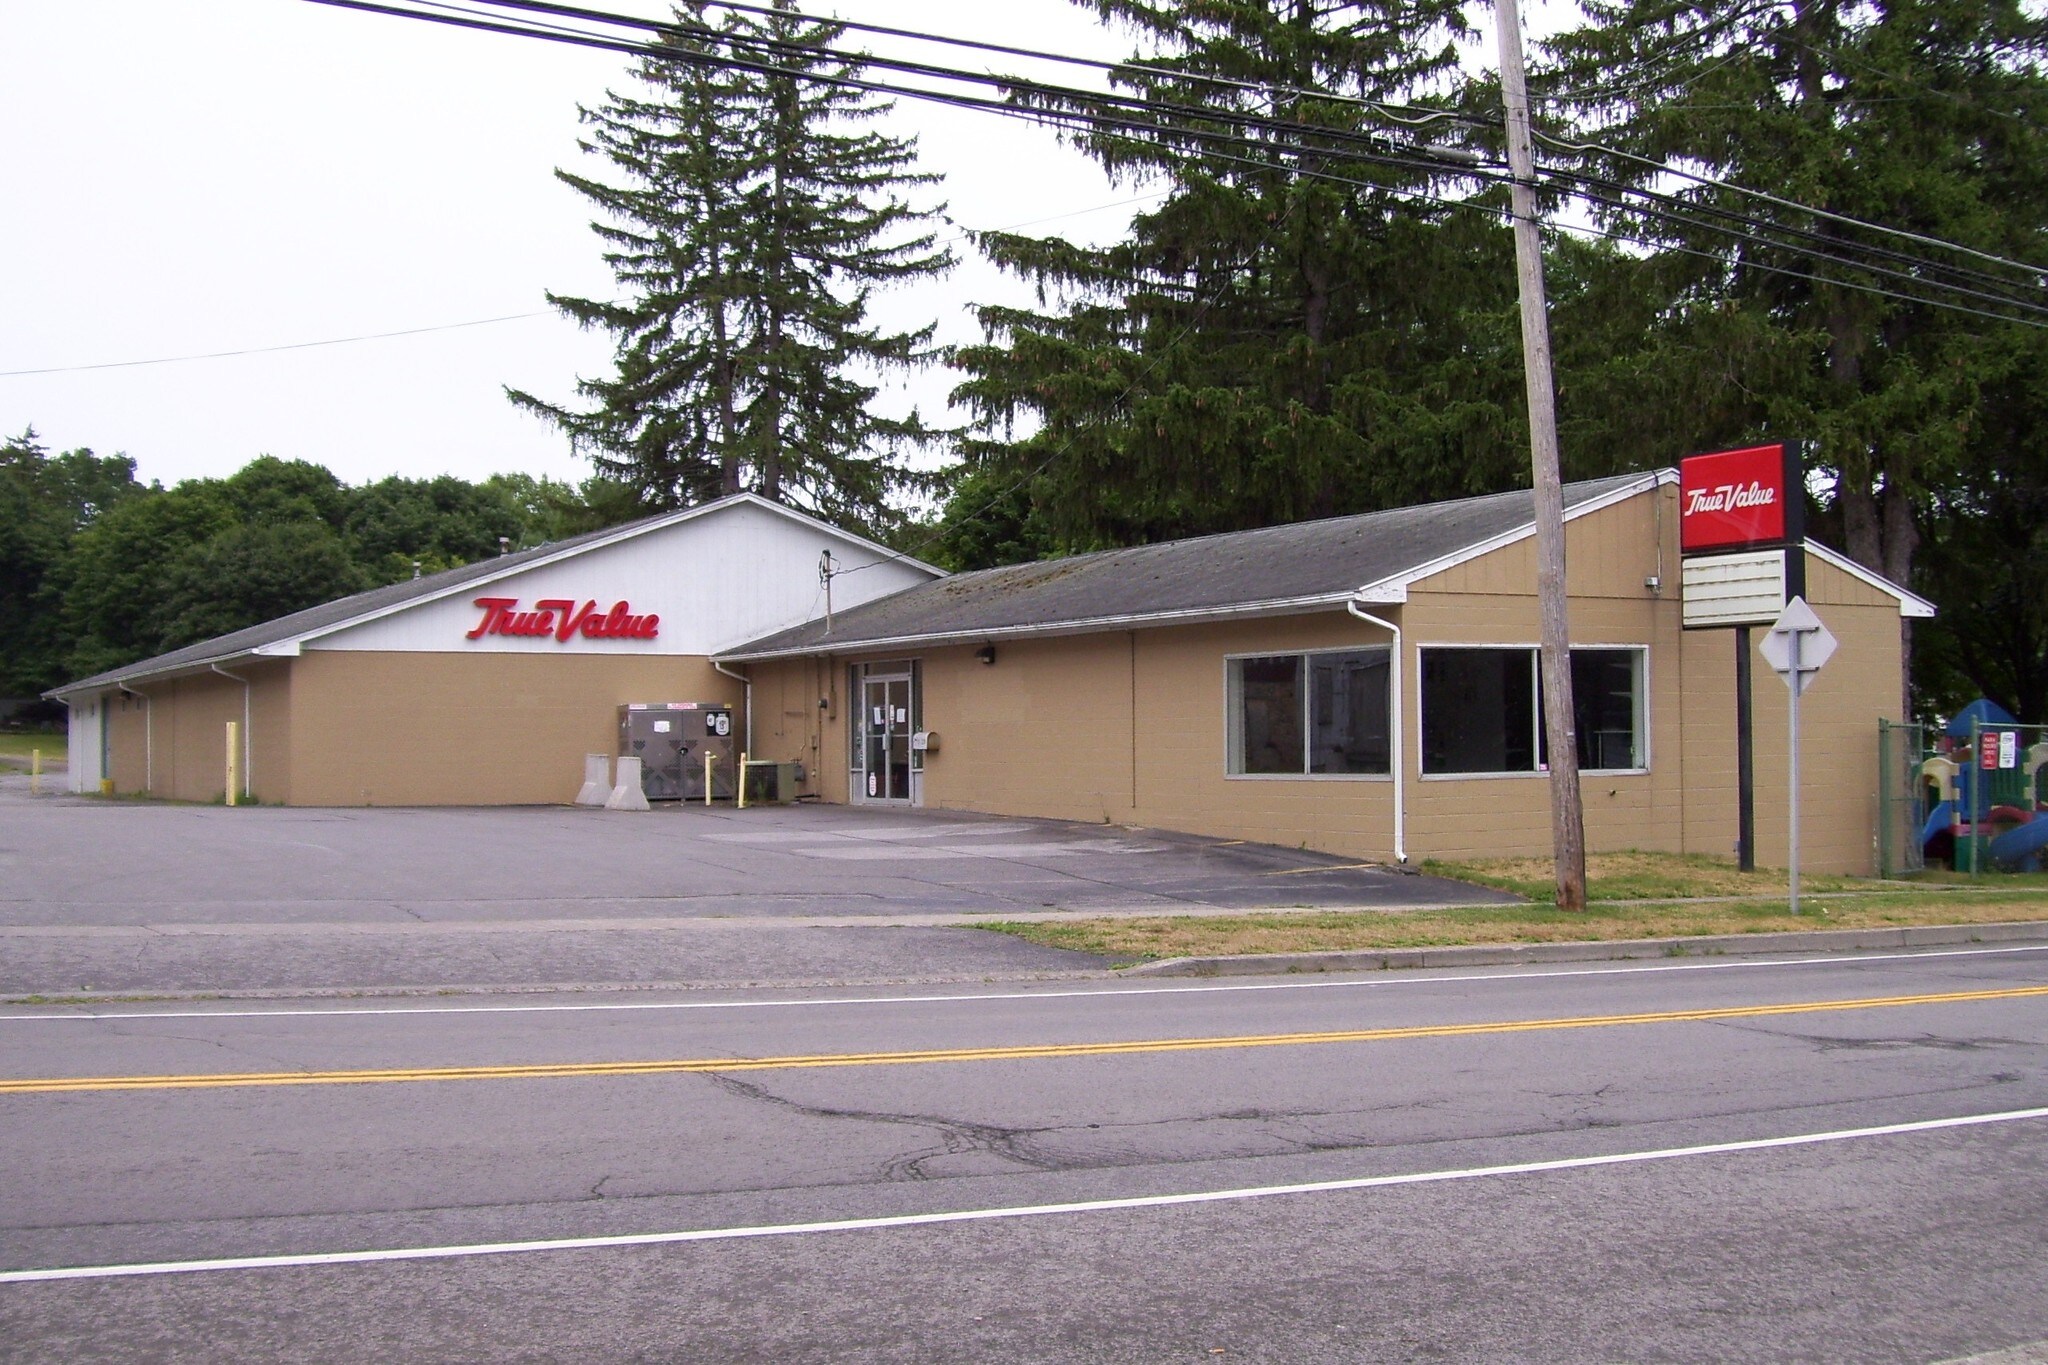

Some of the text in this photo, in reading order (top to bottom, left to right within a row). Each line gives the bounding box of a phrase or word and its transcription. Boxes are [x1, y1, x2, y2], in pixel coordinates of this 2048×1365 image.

[1684, 481, 1774, 516] True Value
[465, 597, 660, 642] True Value
